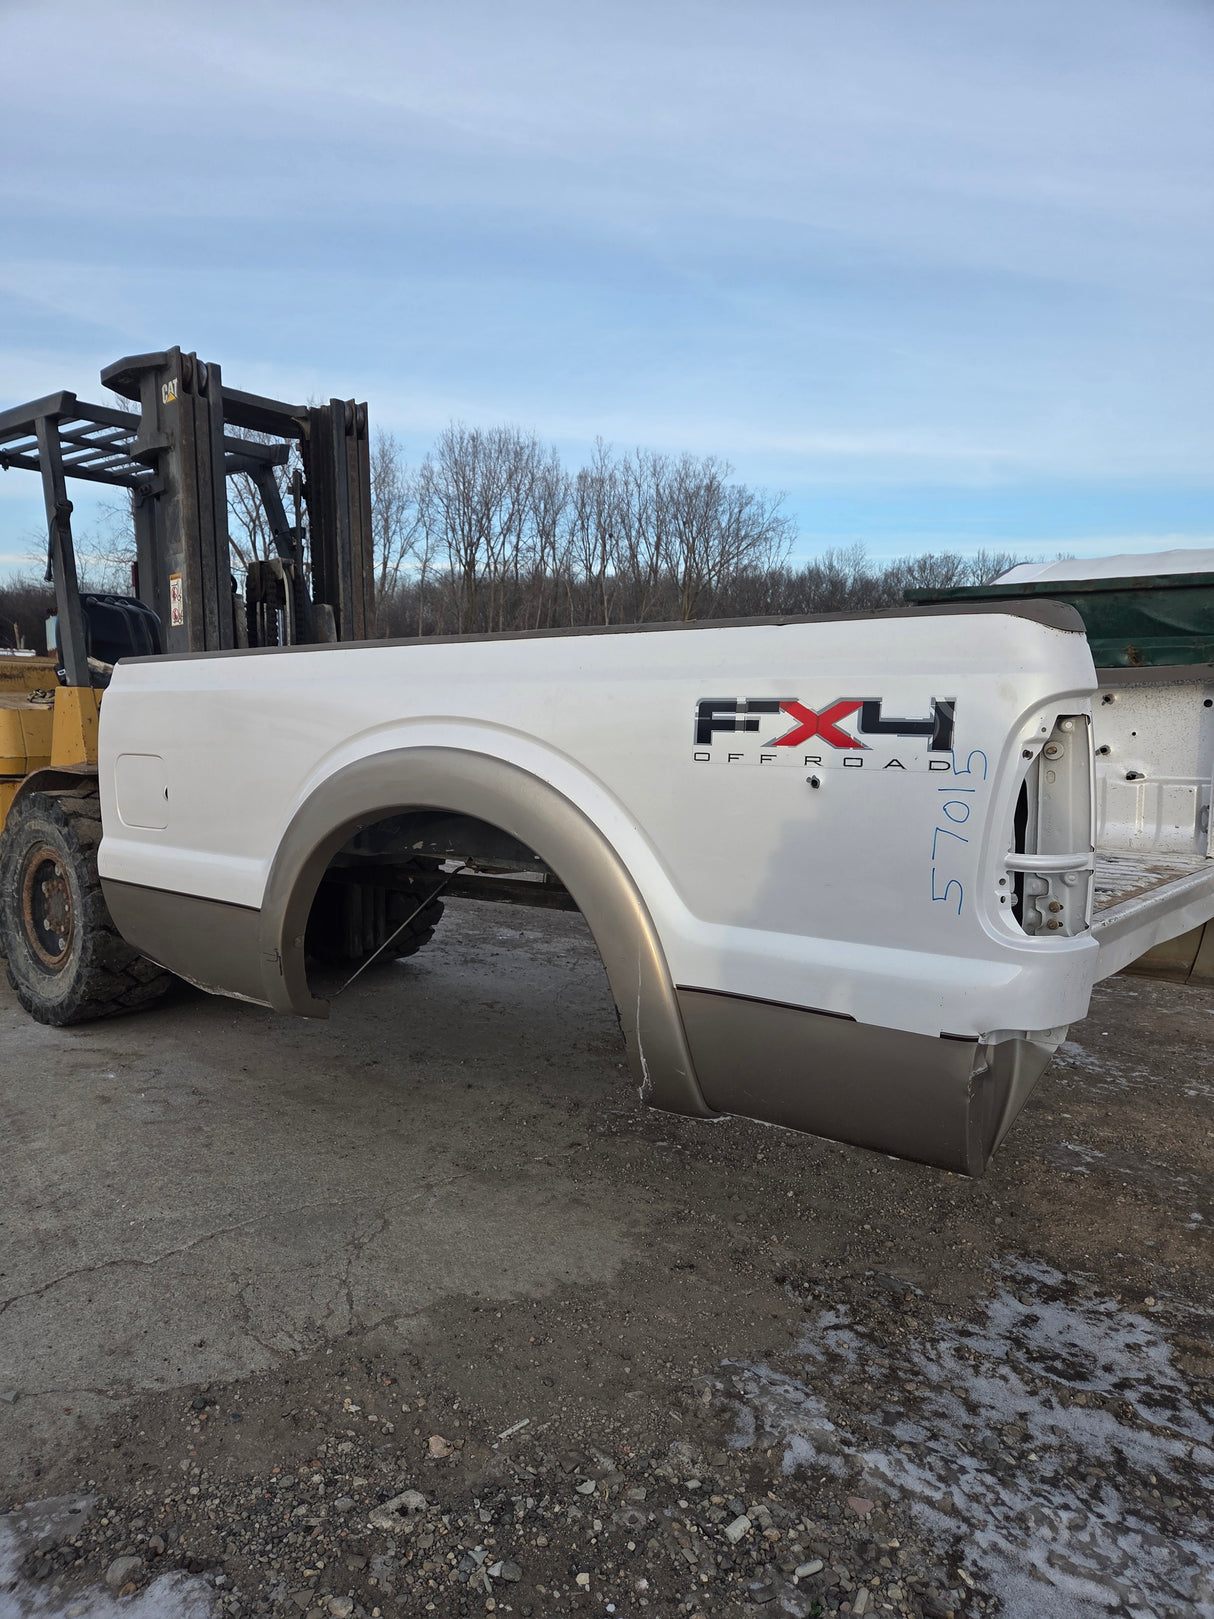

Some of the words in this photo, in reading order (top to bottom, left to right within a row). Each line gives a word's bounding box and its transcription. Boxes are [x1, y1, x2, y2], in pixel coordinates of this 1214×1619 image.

[161, 377, 178, 404] CAT
[694, 697, 957, 752] FX4
[932, 750, 988, 915] 57015
